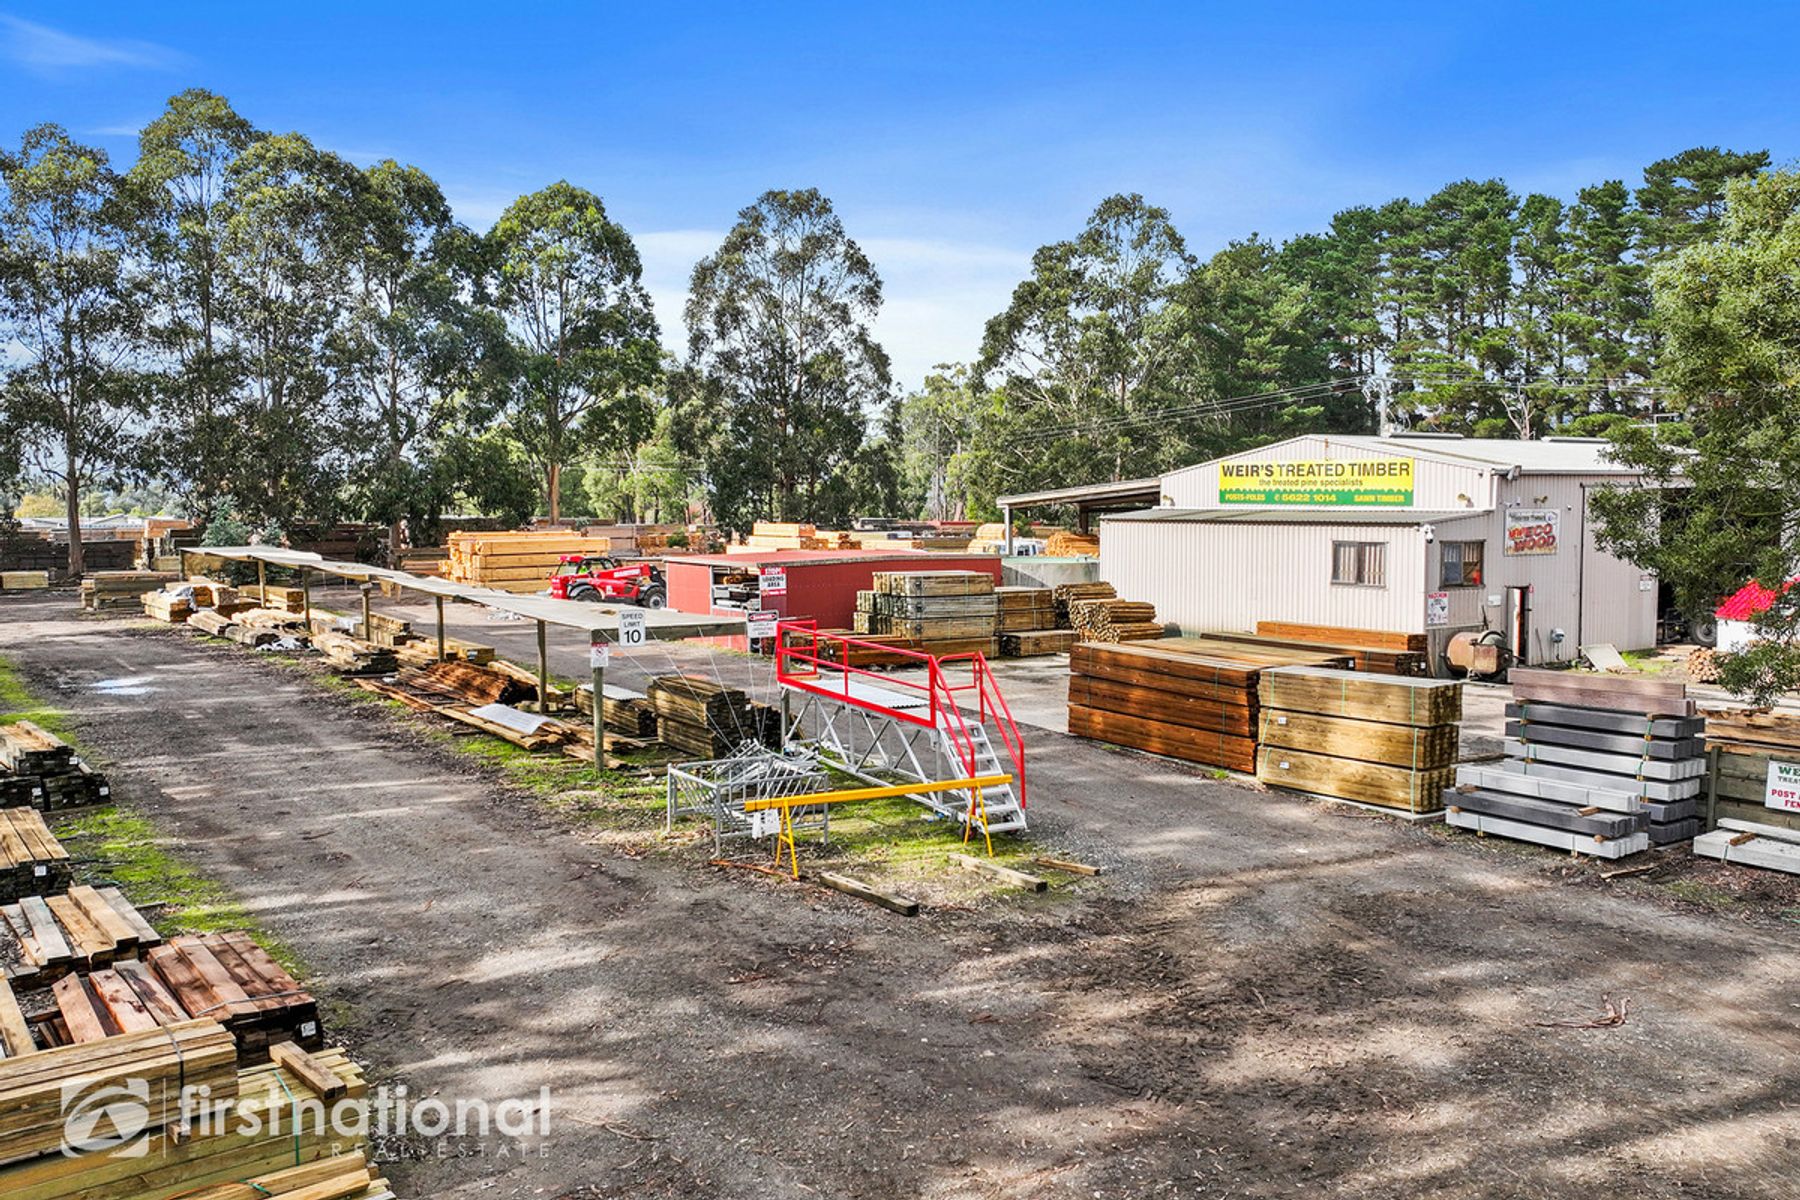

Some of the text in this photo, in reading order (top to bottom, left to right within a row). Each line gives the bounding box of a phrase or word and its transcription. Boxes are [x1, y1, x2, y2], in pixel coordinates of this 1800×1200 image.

[1222, 462, 1410, 477] WEIR'S TREATED TIMBER
[1301, 479, 1318, 488] pine
[1320, 478, 1363, 487] specialists
[1514, 535, 1556, 552] WOOD
[621, 612, 644, 620] SPEED
[624, 629, 641, 643] 10
[1771, 789, 1797, 799] POST
